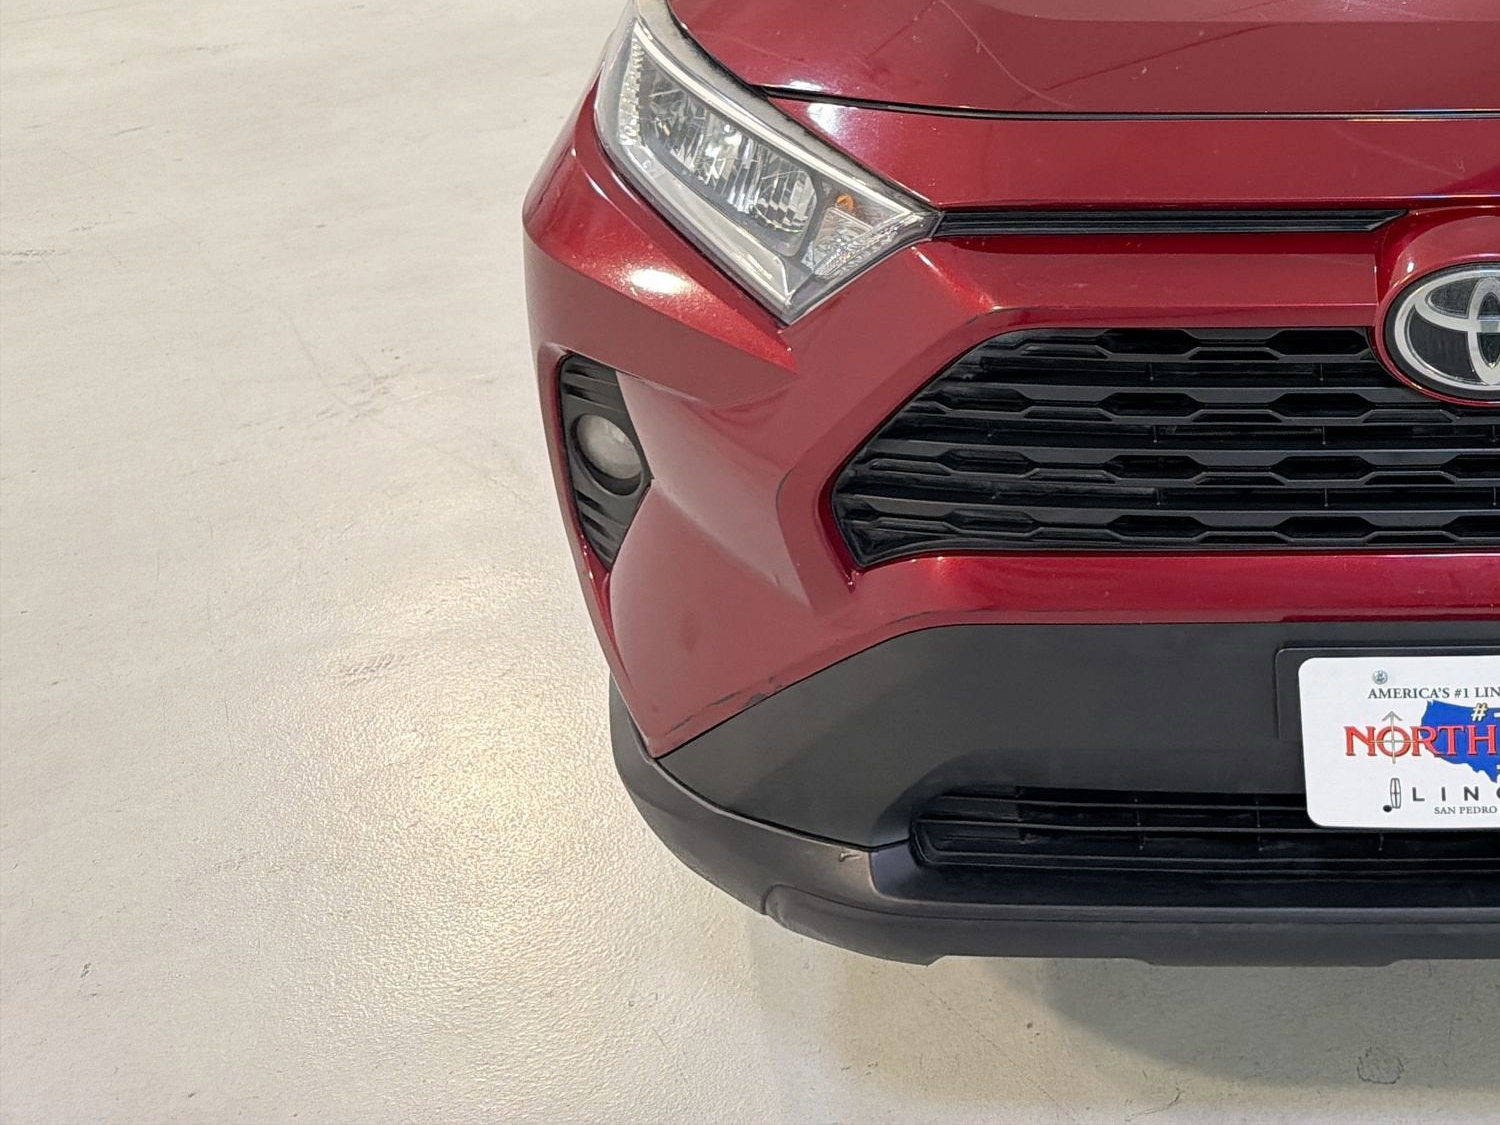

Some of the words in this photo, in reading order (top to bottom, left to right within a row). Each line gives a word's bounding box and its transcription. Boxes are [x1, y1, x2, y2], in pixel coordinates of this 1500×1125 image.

[1367, 687, 1450, 700] AMERICA'S
[1454, 687, 1469, 699] #1
[1344, 724, 1497, 759] NORTH
[1434, 806, 1456, 815] SAN
[1459, 805, 1498, 815] PEDRO
